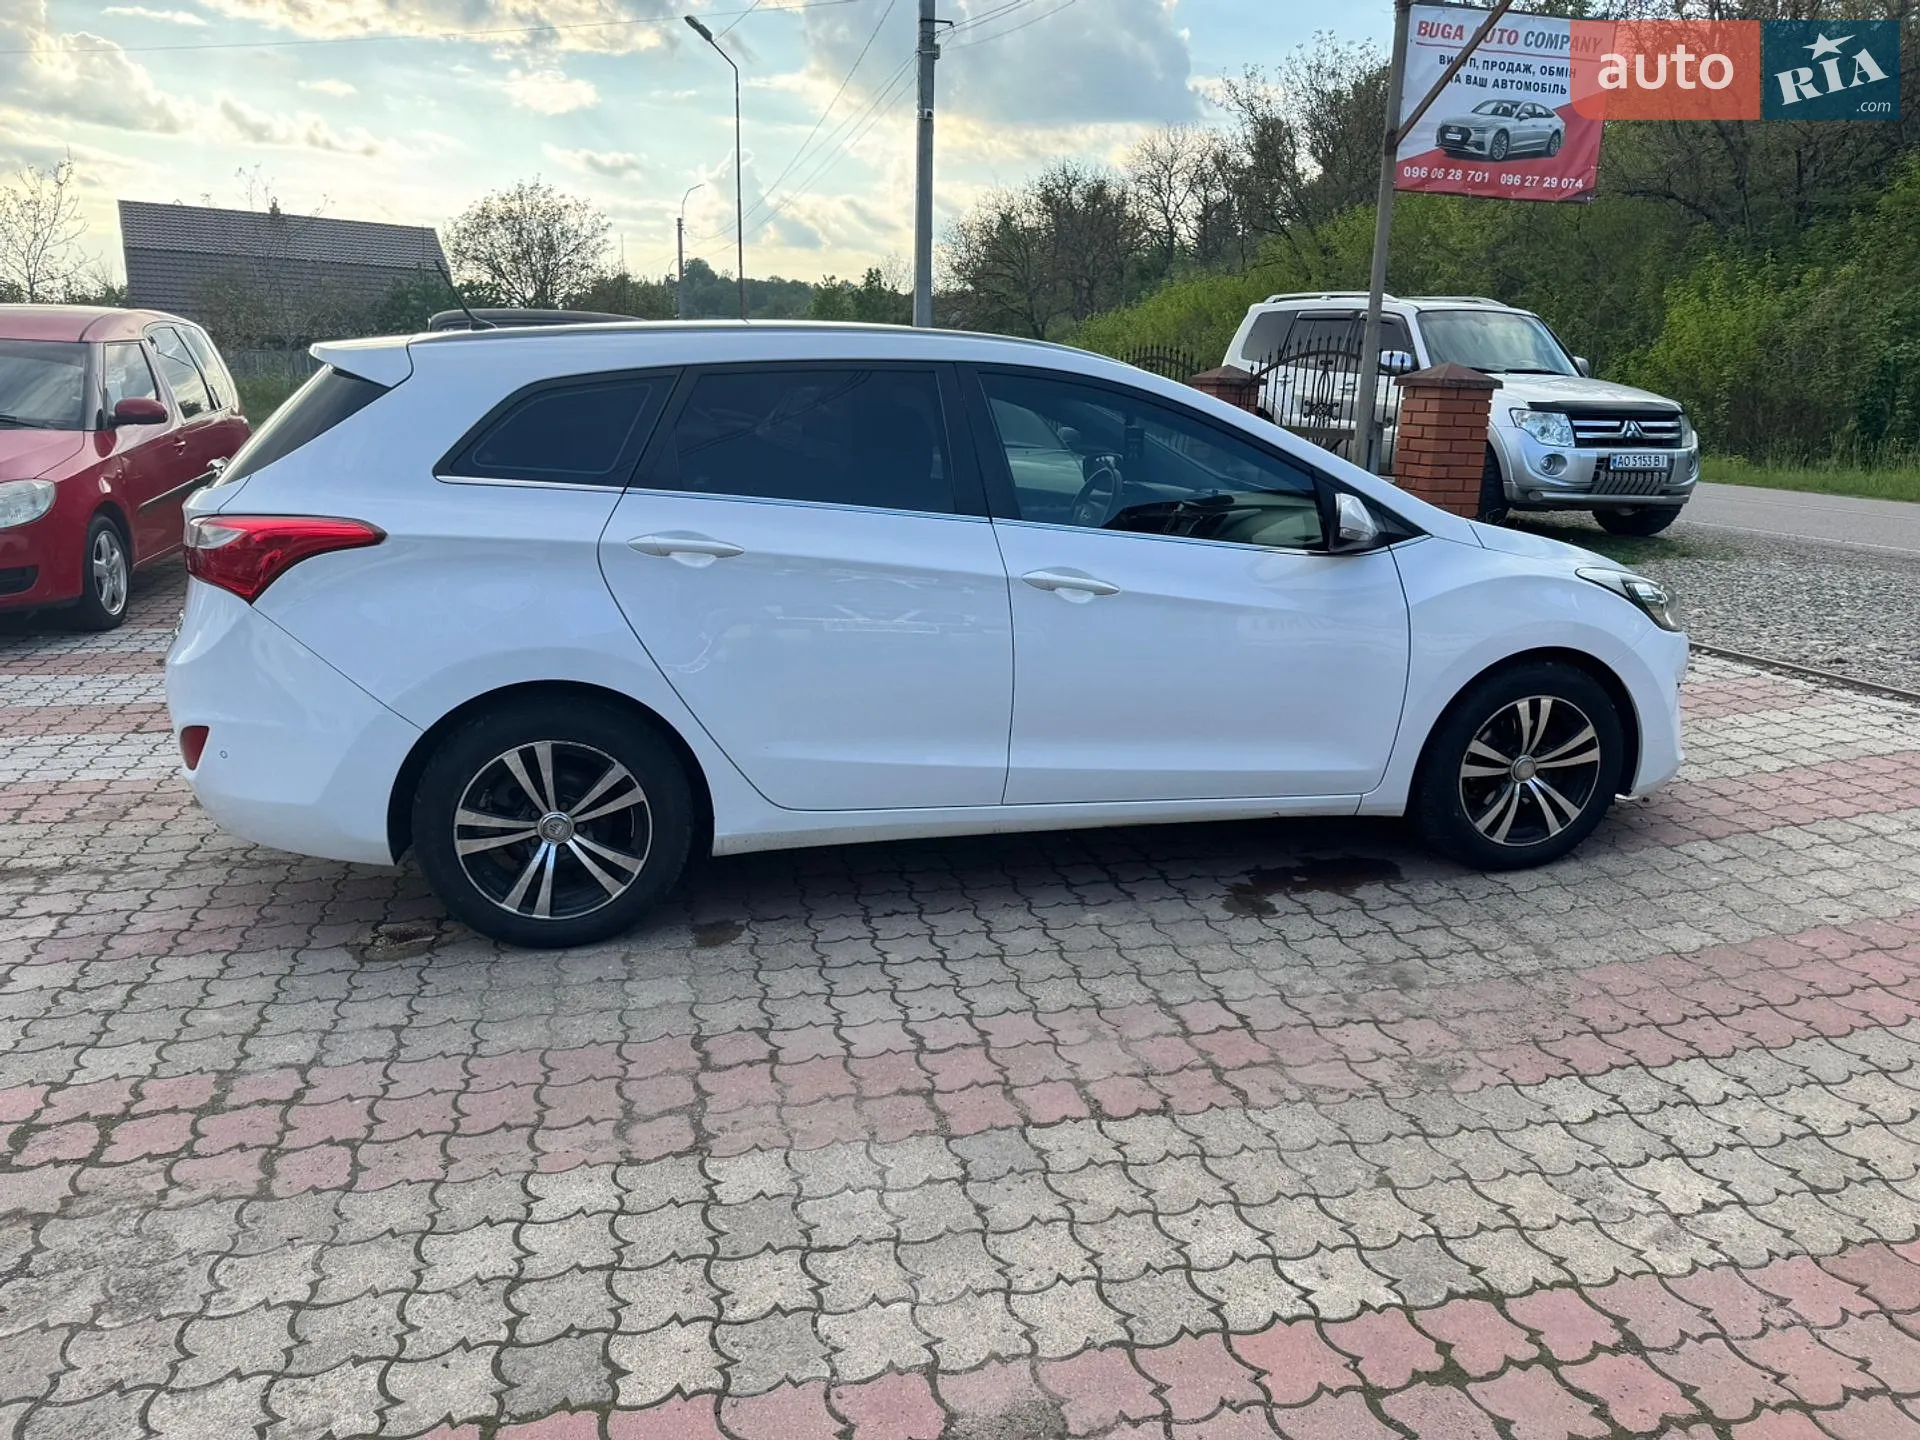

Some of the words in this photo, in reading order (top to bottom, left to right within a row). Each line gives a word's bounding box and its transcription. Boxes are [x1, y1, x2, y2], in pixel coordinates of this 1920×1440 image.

[1417, 20, 1464, 40] BUGA
[1481, 27, 1519, 46] UTO
[1523, 30, 1603, 53] COMPANY
[1482, 59, 1535, 77] ПРОДАЖ,
[1540, 65, 1576, 79] ОБМІН
[1465, 74, 1488, 88] ВАШ
[1492, 77, 1567, 95] АВТОМОБІЛЬ
[1403, 166, 1429, 178] 096
[1446, 169, 1463, 180] 28
[1467, 170, 1490, 183] 701
[1500, 173, 1521, 185] 096
[1524, 175, 1540, 187] 27
[1542, 176, 1558, 188] 29
[1560, 177, 1584, 189] 074
